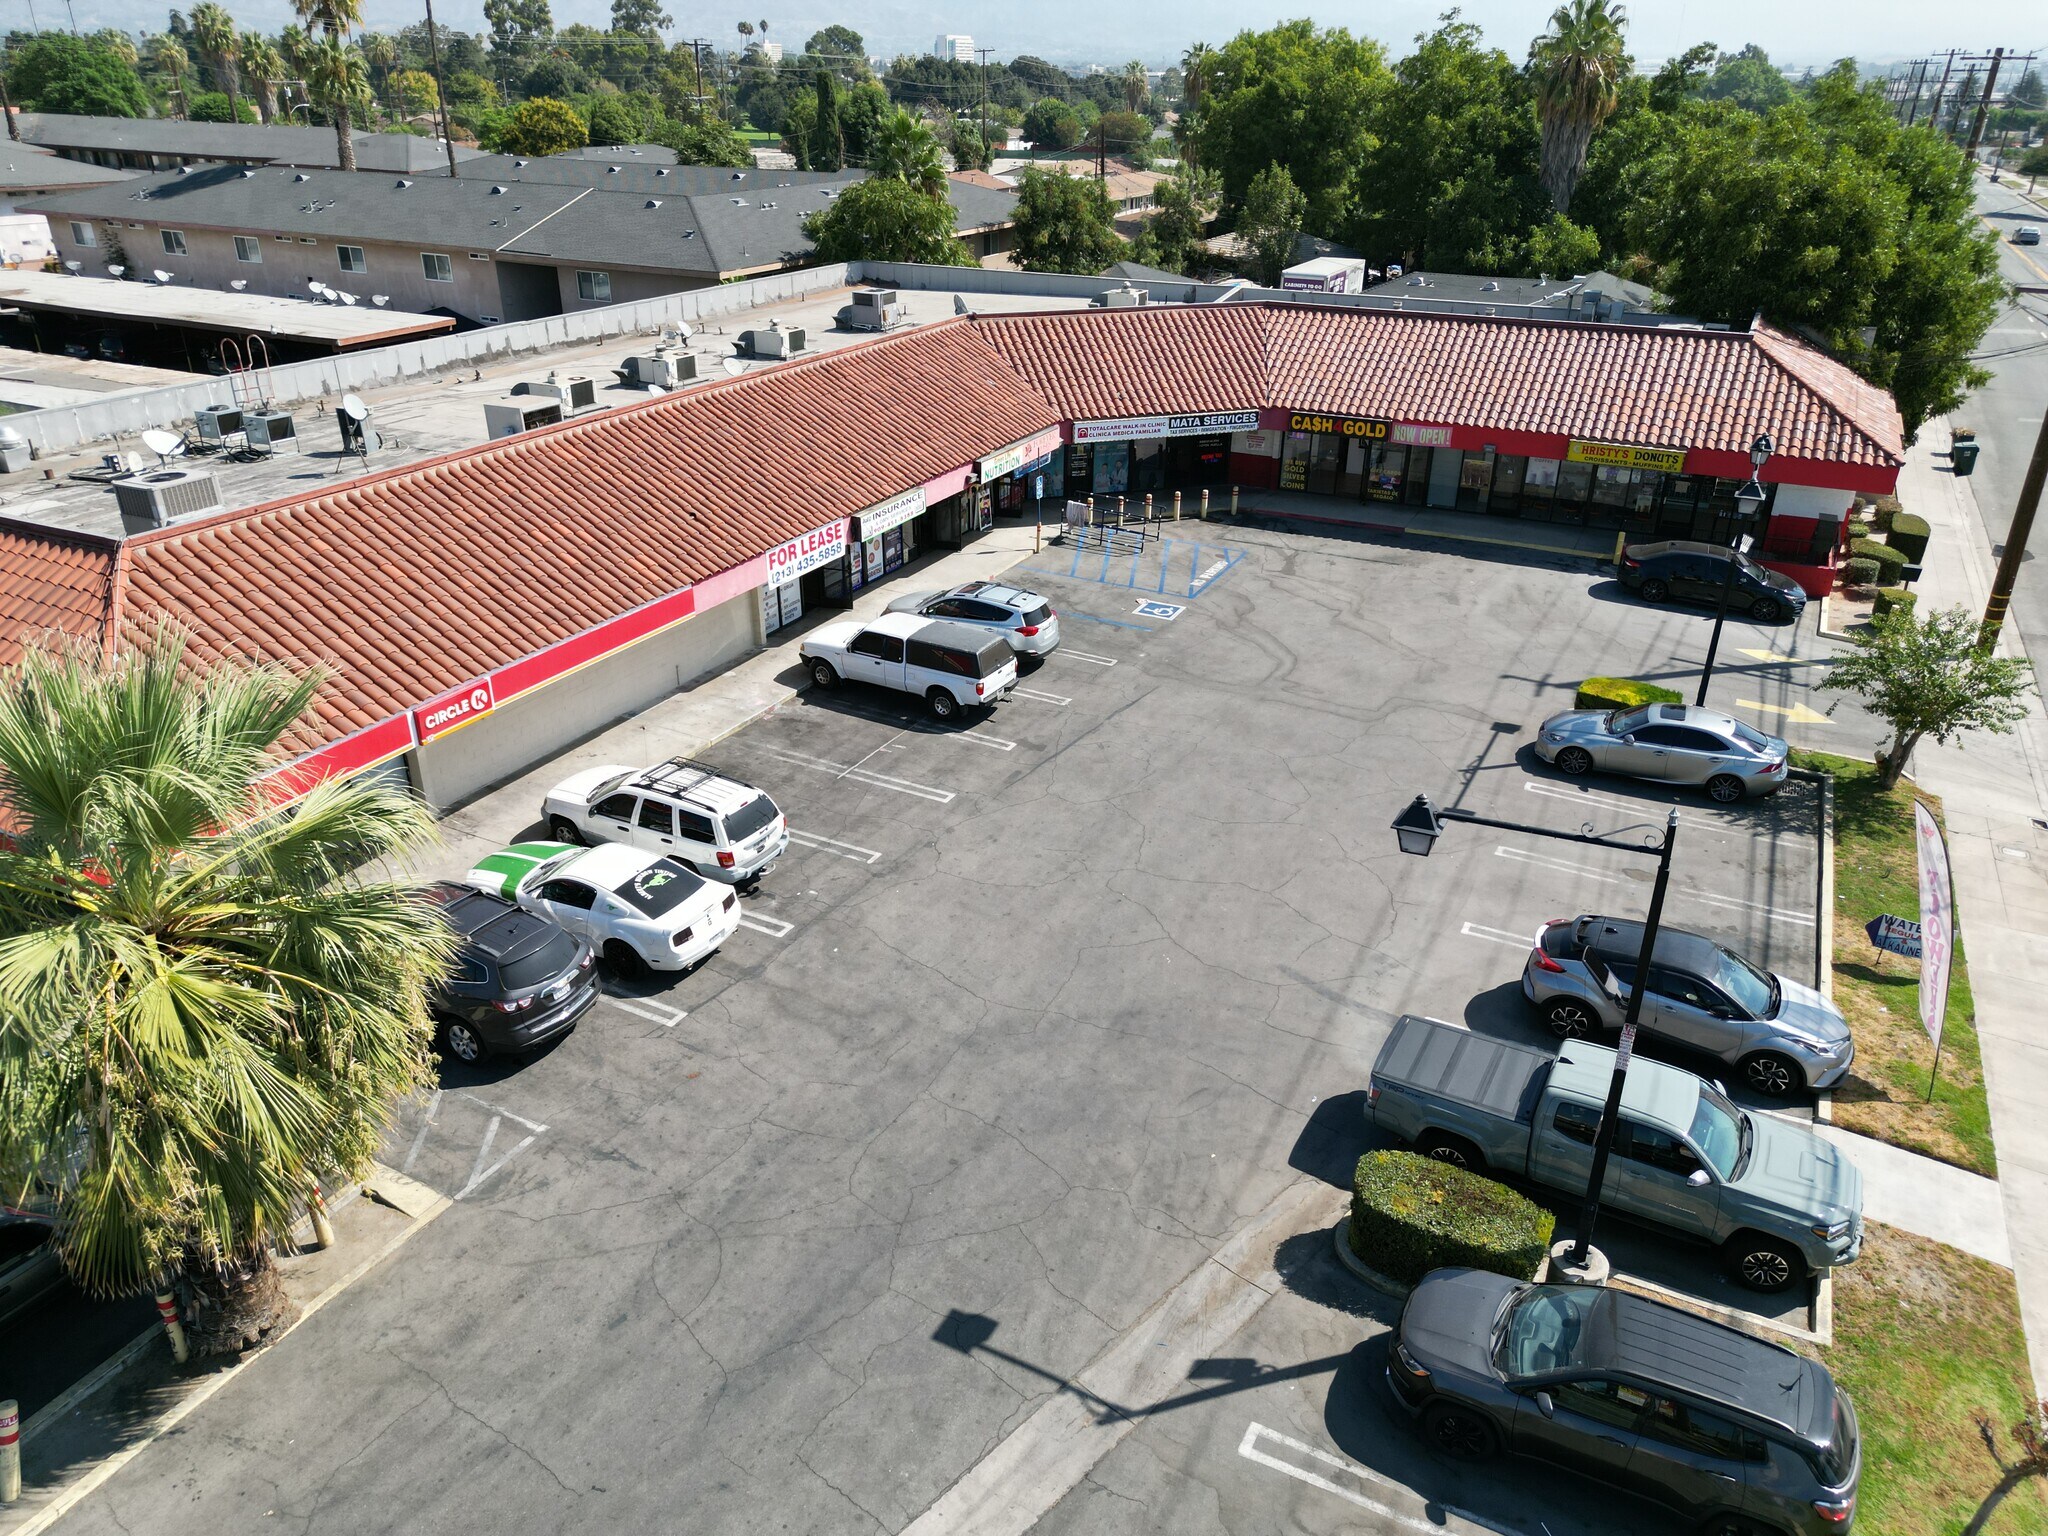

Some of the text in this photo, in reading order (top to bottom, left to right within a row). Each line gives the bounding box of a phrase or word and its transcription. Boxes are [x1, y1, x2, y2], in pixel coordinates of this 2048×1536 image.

[1171, 413, 1257, 428] MATA SERVICES
[1291, 415, 1332, 433] CA$H
[1343, 422, 1386, 438] GOLD
[1089, 430, 1112, 438] CLINICA
[1393, 424, 1450, 445] NOW OPEN!
[1585, 456, 1628, 465] CROISSANTS
[1634, 451, 1679, 464] DONUTS
[985, 455, 1020, 480] NUTRITION
[1284, 465, 1304, 473] GOLD
[1281, 481, 1304, 490] COINS
[872, 493, 922, 520] INSURANCE
[769, 522, 842, 570] FOR LEASE
[772, 542, 842, 583] (213) 435-5858
[425, 699, 470, 728] CIRCLE
[1884, 914, 1921, 933] WATE
[1885, 925, 1922, 940] REGULA
[1875, 939, 1922, 957] ALKALINE
